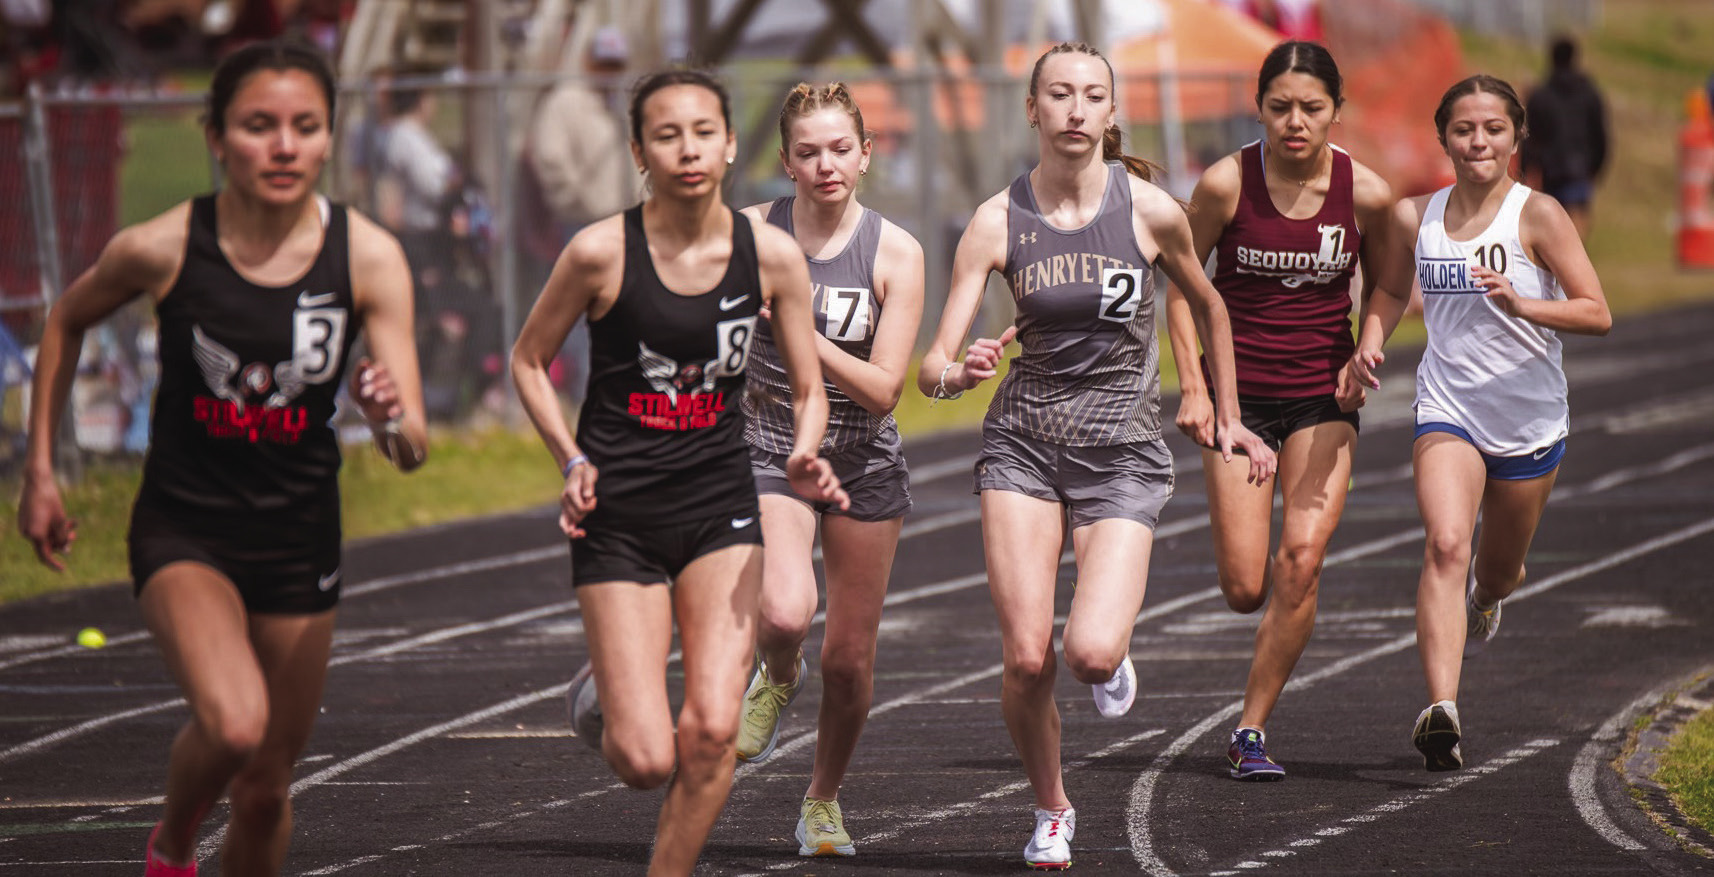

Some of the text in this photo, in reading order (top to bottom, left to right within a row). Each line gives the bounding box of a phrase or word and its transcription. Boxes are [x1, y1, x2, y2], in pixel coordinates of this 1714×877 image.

[1331, 230, 1342, 262] 1
[1475, 243, 1507, 276] 10
[1012, 253, 1136, 300] HENRYETT
[1103, 273, 1136, 318] 2
[1420, 263, 1476, 290] HOLDEN
[837, 291, 861, 337] 7
[304, 318, 332, 374] 3
[726, 325, 748, 372] 8
[628, 392, 726, 416] STILWELL
